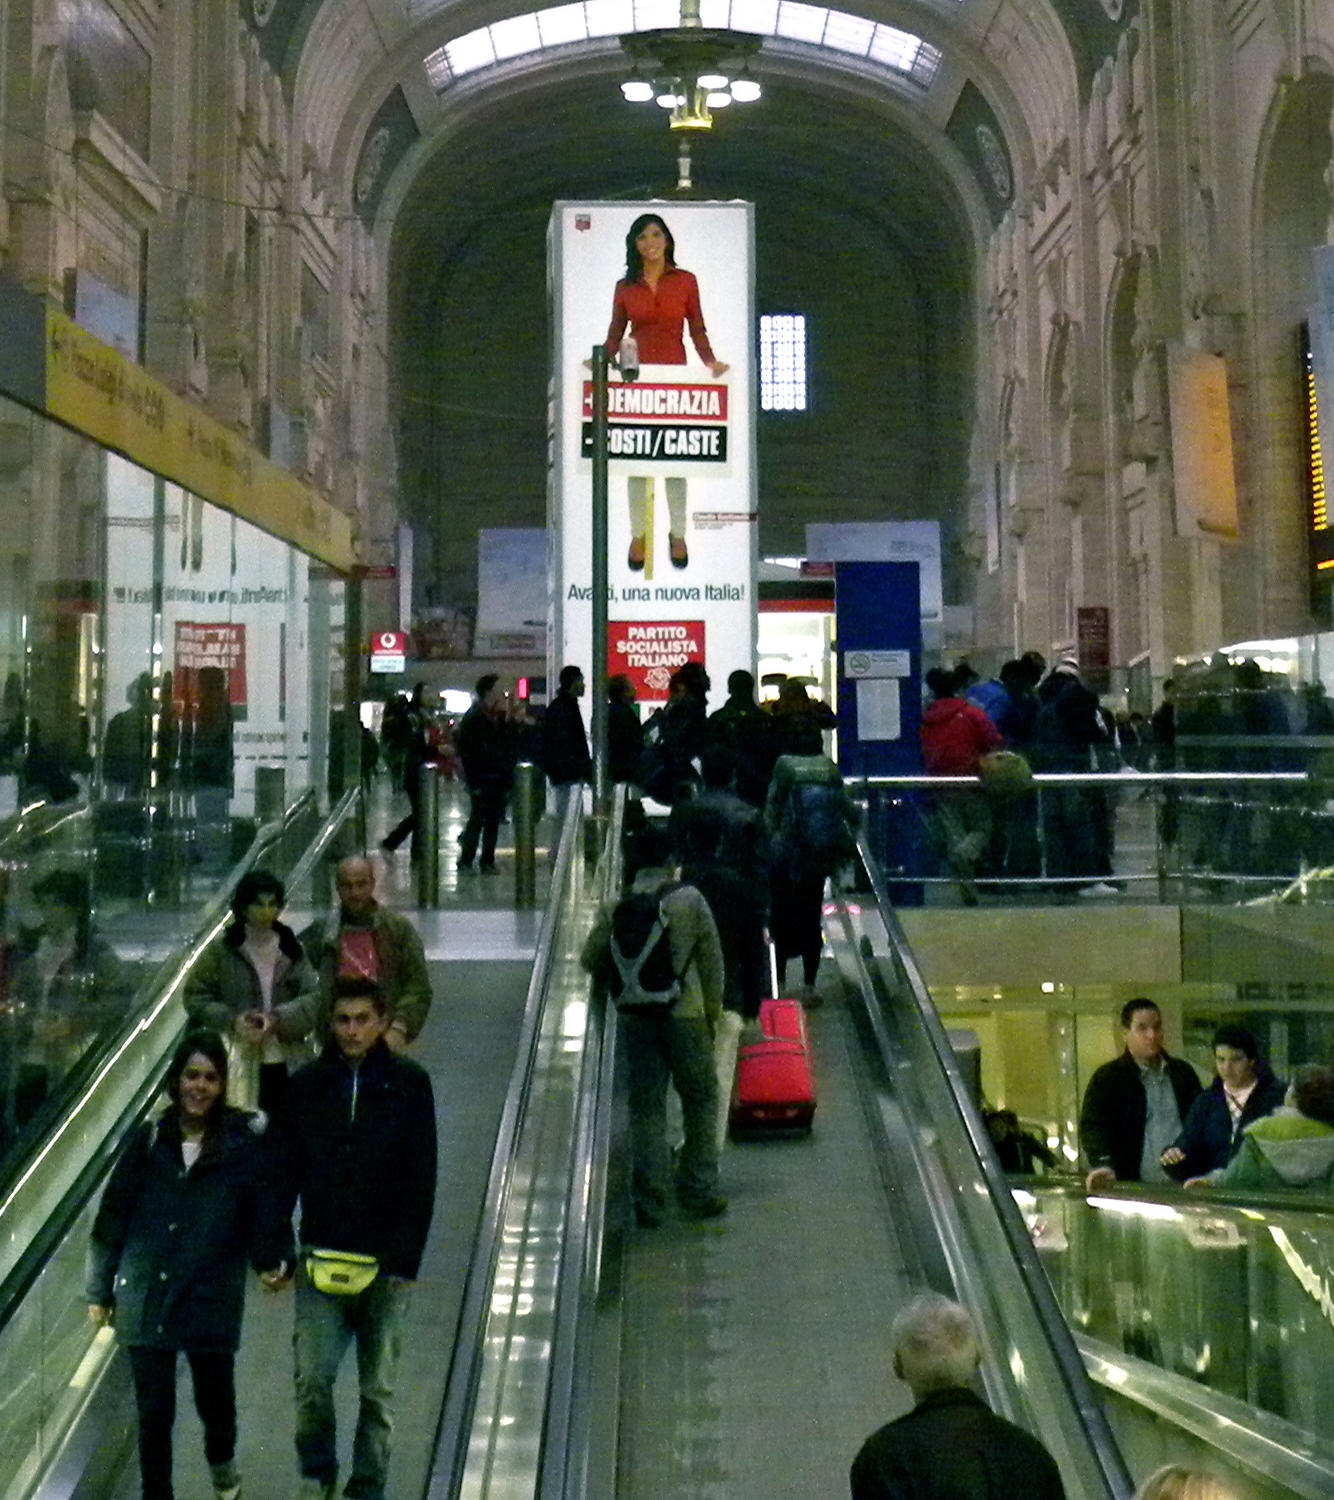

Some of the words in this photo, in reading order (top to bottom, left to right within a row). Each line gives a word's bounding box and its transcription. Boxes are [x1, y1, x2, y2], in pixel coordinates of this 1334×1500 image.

[608, 387, 720, 415] DEMOCRAZIA
[622, 588, 651, 602] una
[655, 588, 700, 602] nuova
[705, 585, 745, 601] Italia!
[628, 627, 687, 639] PARTITO
[617, 641, 698, 653] SOCIALISTA
[628, 655, 688, 667] ITALIANO
